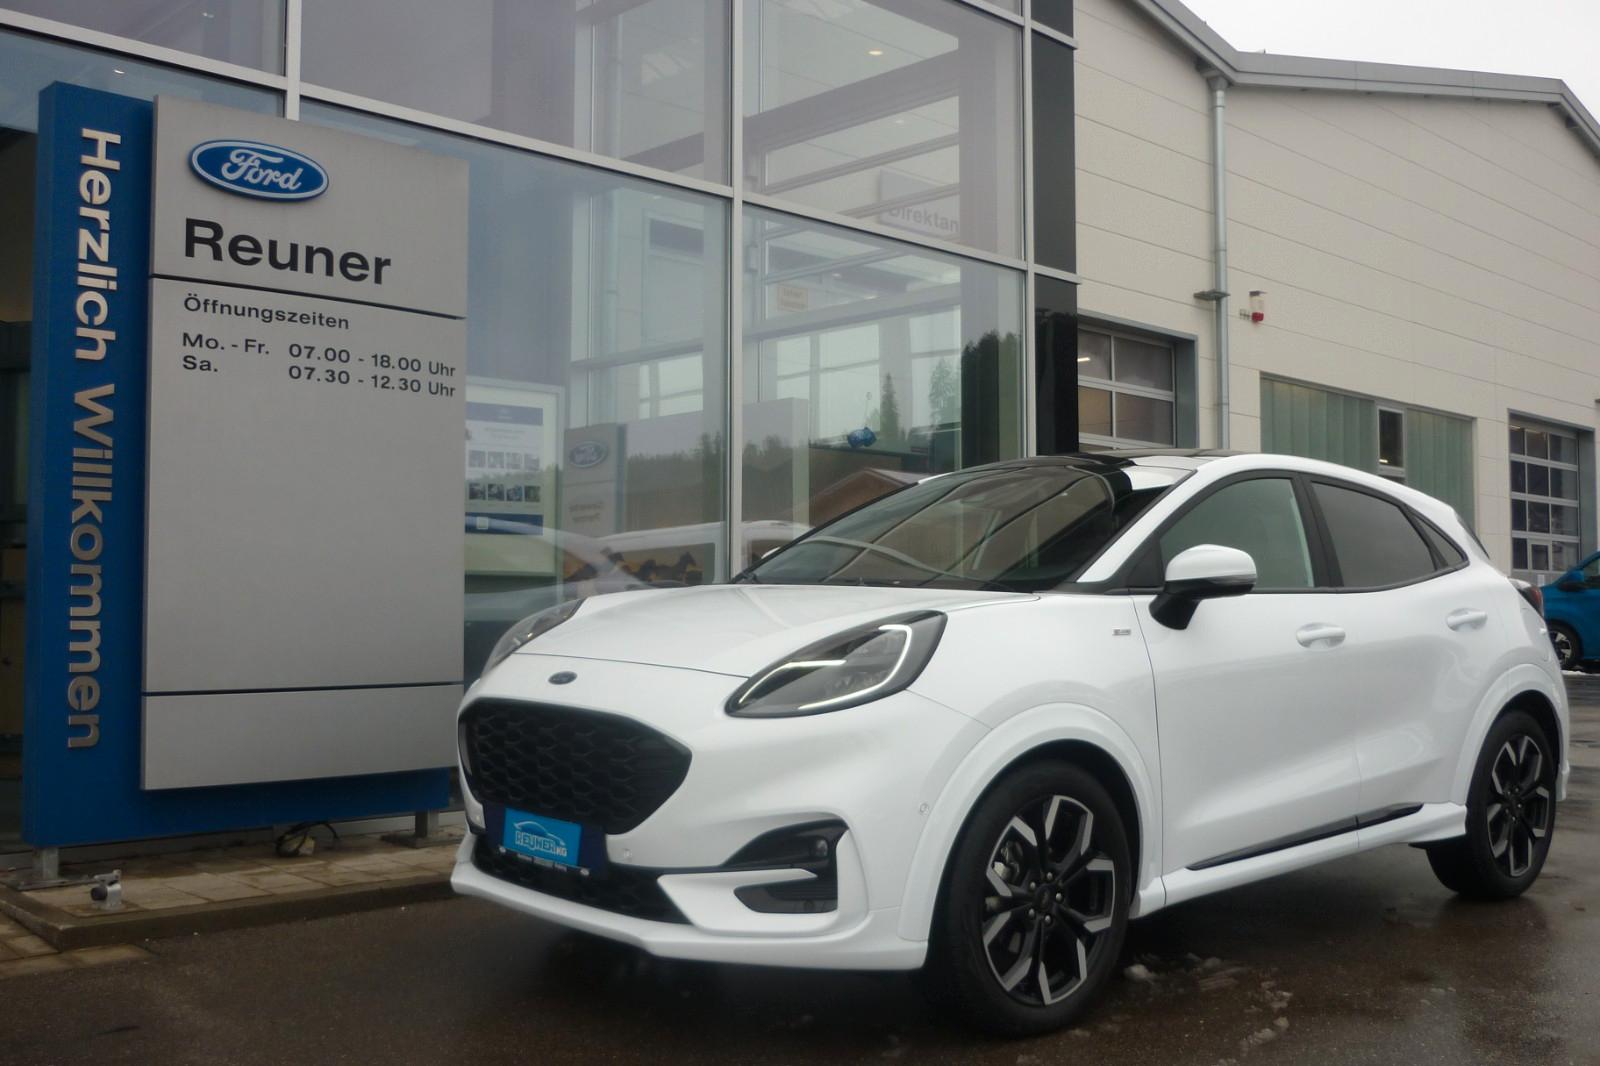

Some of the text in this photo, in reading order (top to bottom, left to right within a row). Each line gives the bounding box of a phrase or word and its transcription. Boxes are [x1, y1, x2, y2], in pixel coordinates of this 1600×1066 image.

[220, 148, 304, 191] Ford
[185, 217, 391, 285] Reuner
[183, 292, 349, 330] Öffnungszeiten
[182, 332, 225, 351] Mo.
[244, 338, 270, 355] Fr.
[289, 343, 350, 363] 07.00
[371, 353, 422, 373] 18.00
[428, 361, 456, 377] Uhr
[182, 355, 219, 373] Sa.
[288, 365, 350, 385] 07.30
[371, 374, 421, 393] 12.30
[428, 381, 456, 398] Uhr
[67, 127, 121, 749] Herzlich Willkommen
